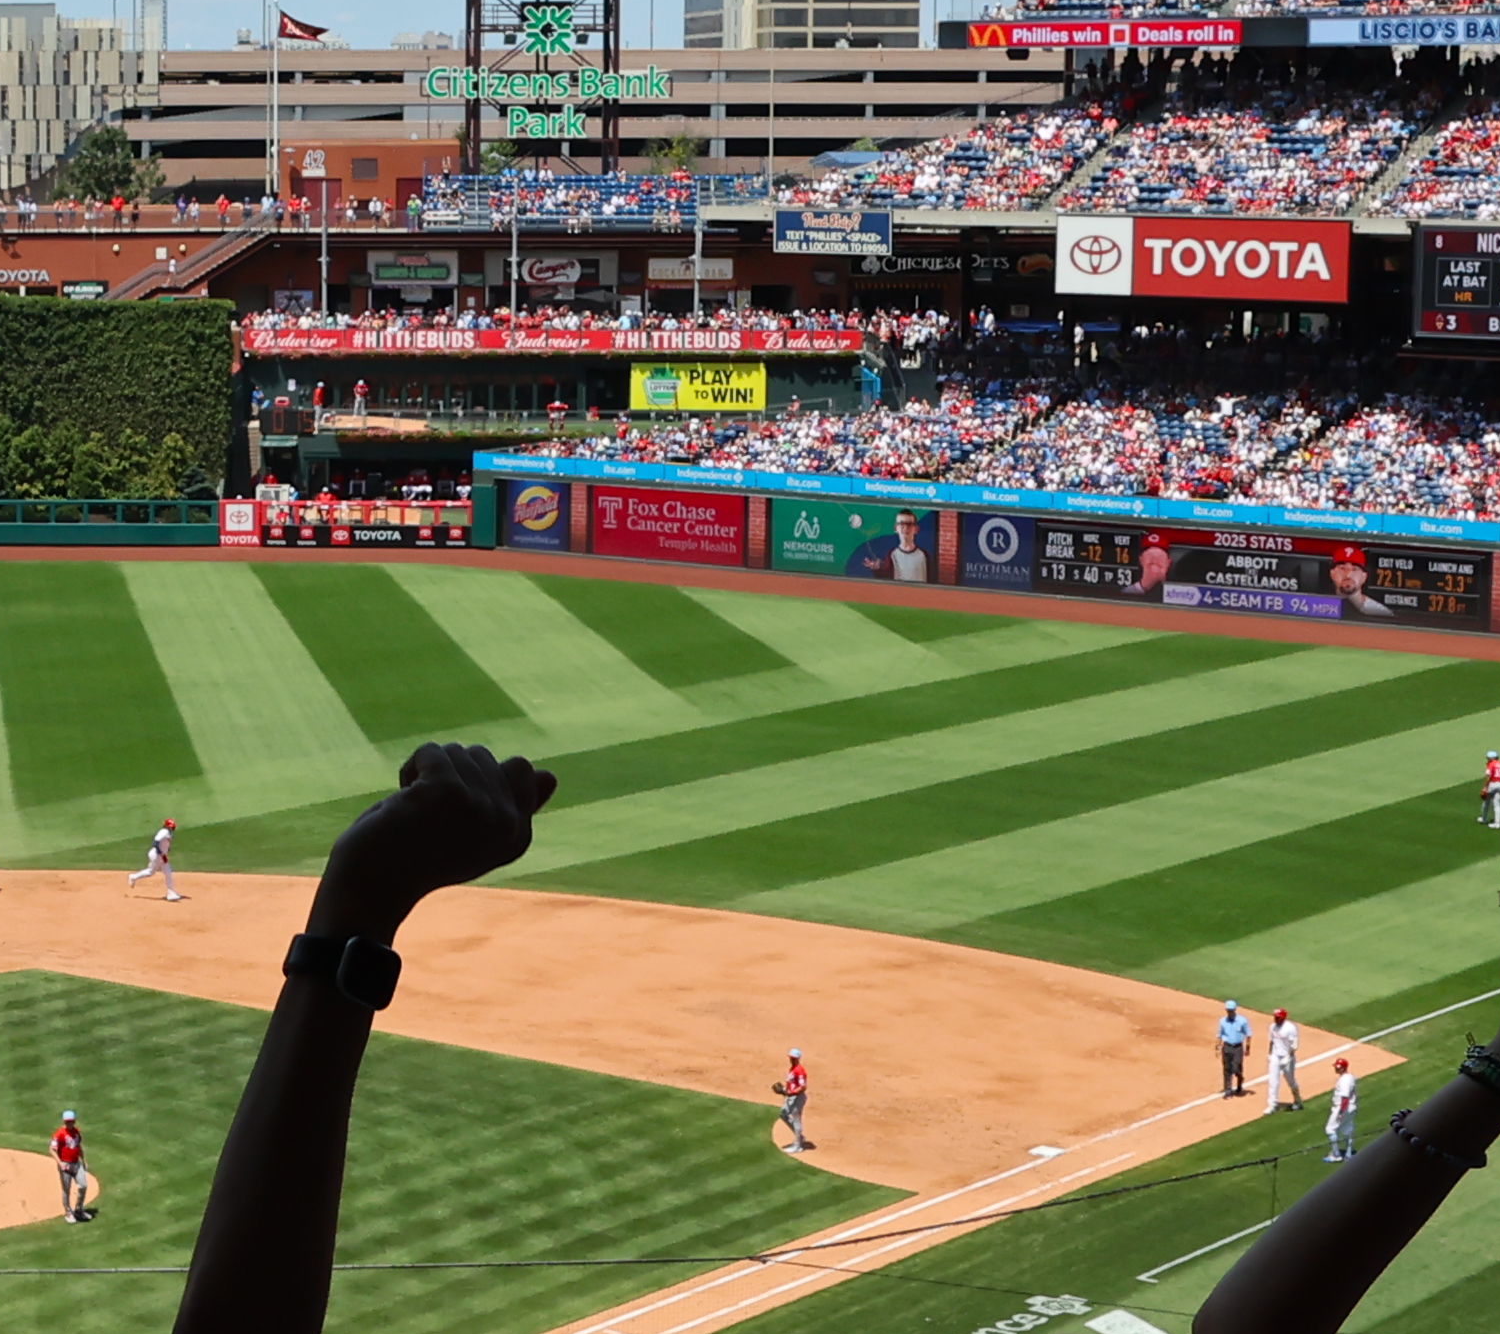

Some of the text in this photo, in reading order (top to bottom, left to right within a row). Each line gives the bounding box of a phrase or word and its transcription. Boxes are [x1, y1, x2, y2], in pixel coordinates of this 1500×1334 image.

[1012, 25, 1234, 44] Phillies win Deals roll in
[1358, 18, 1455, 42] LISCIO'S
[426, 64, 670, 100] Citizens Bank
[506, 104, 587, 140] Park
[784, 229, 806, 241] TEXT
[1143, 237, 1332, 281] TOYOTA
[250, 330, 340, 350] Budweiser
[352, 329, 476, 350] #HITTHEBUDS
[688, 369, 733, 387] PLAY
[694, 386, 755, 405] TO WIN!
[626, 497, 717, 522] Fox Chase
[626, 514, 738, 539] Cancer Center
[657, 536, 738, 554] Temple Health
[1213, 532, 1293, 552] 2025 STATS
[1225, 554, 1279, 571] ABBOTT
[1205, 571, 1299, 591] CASTELLANOS
[1202, 588, 1339, 616] 4-SEAM FB 94 MPH
